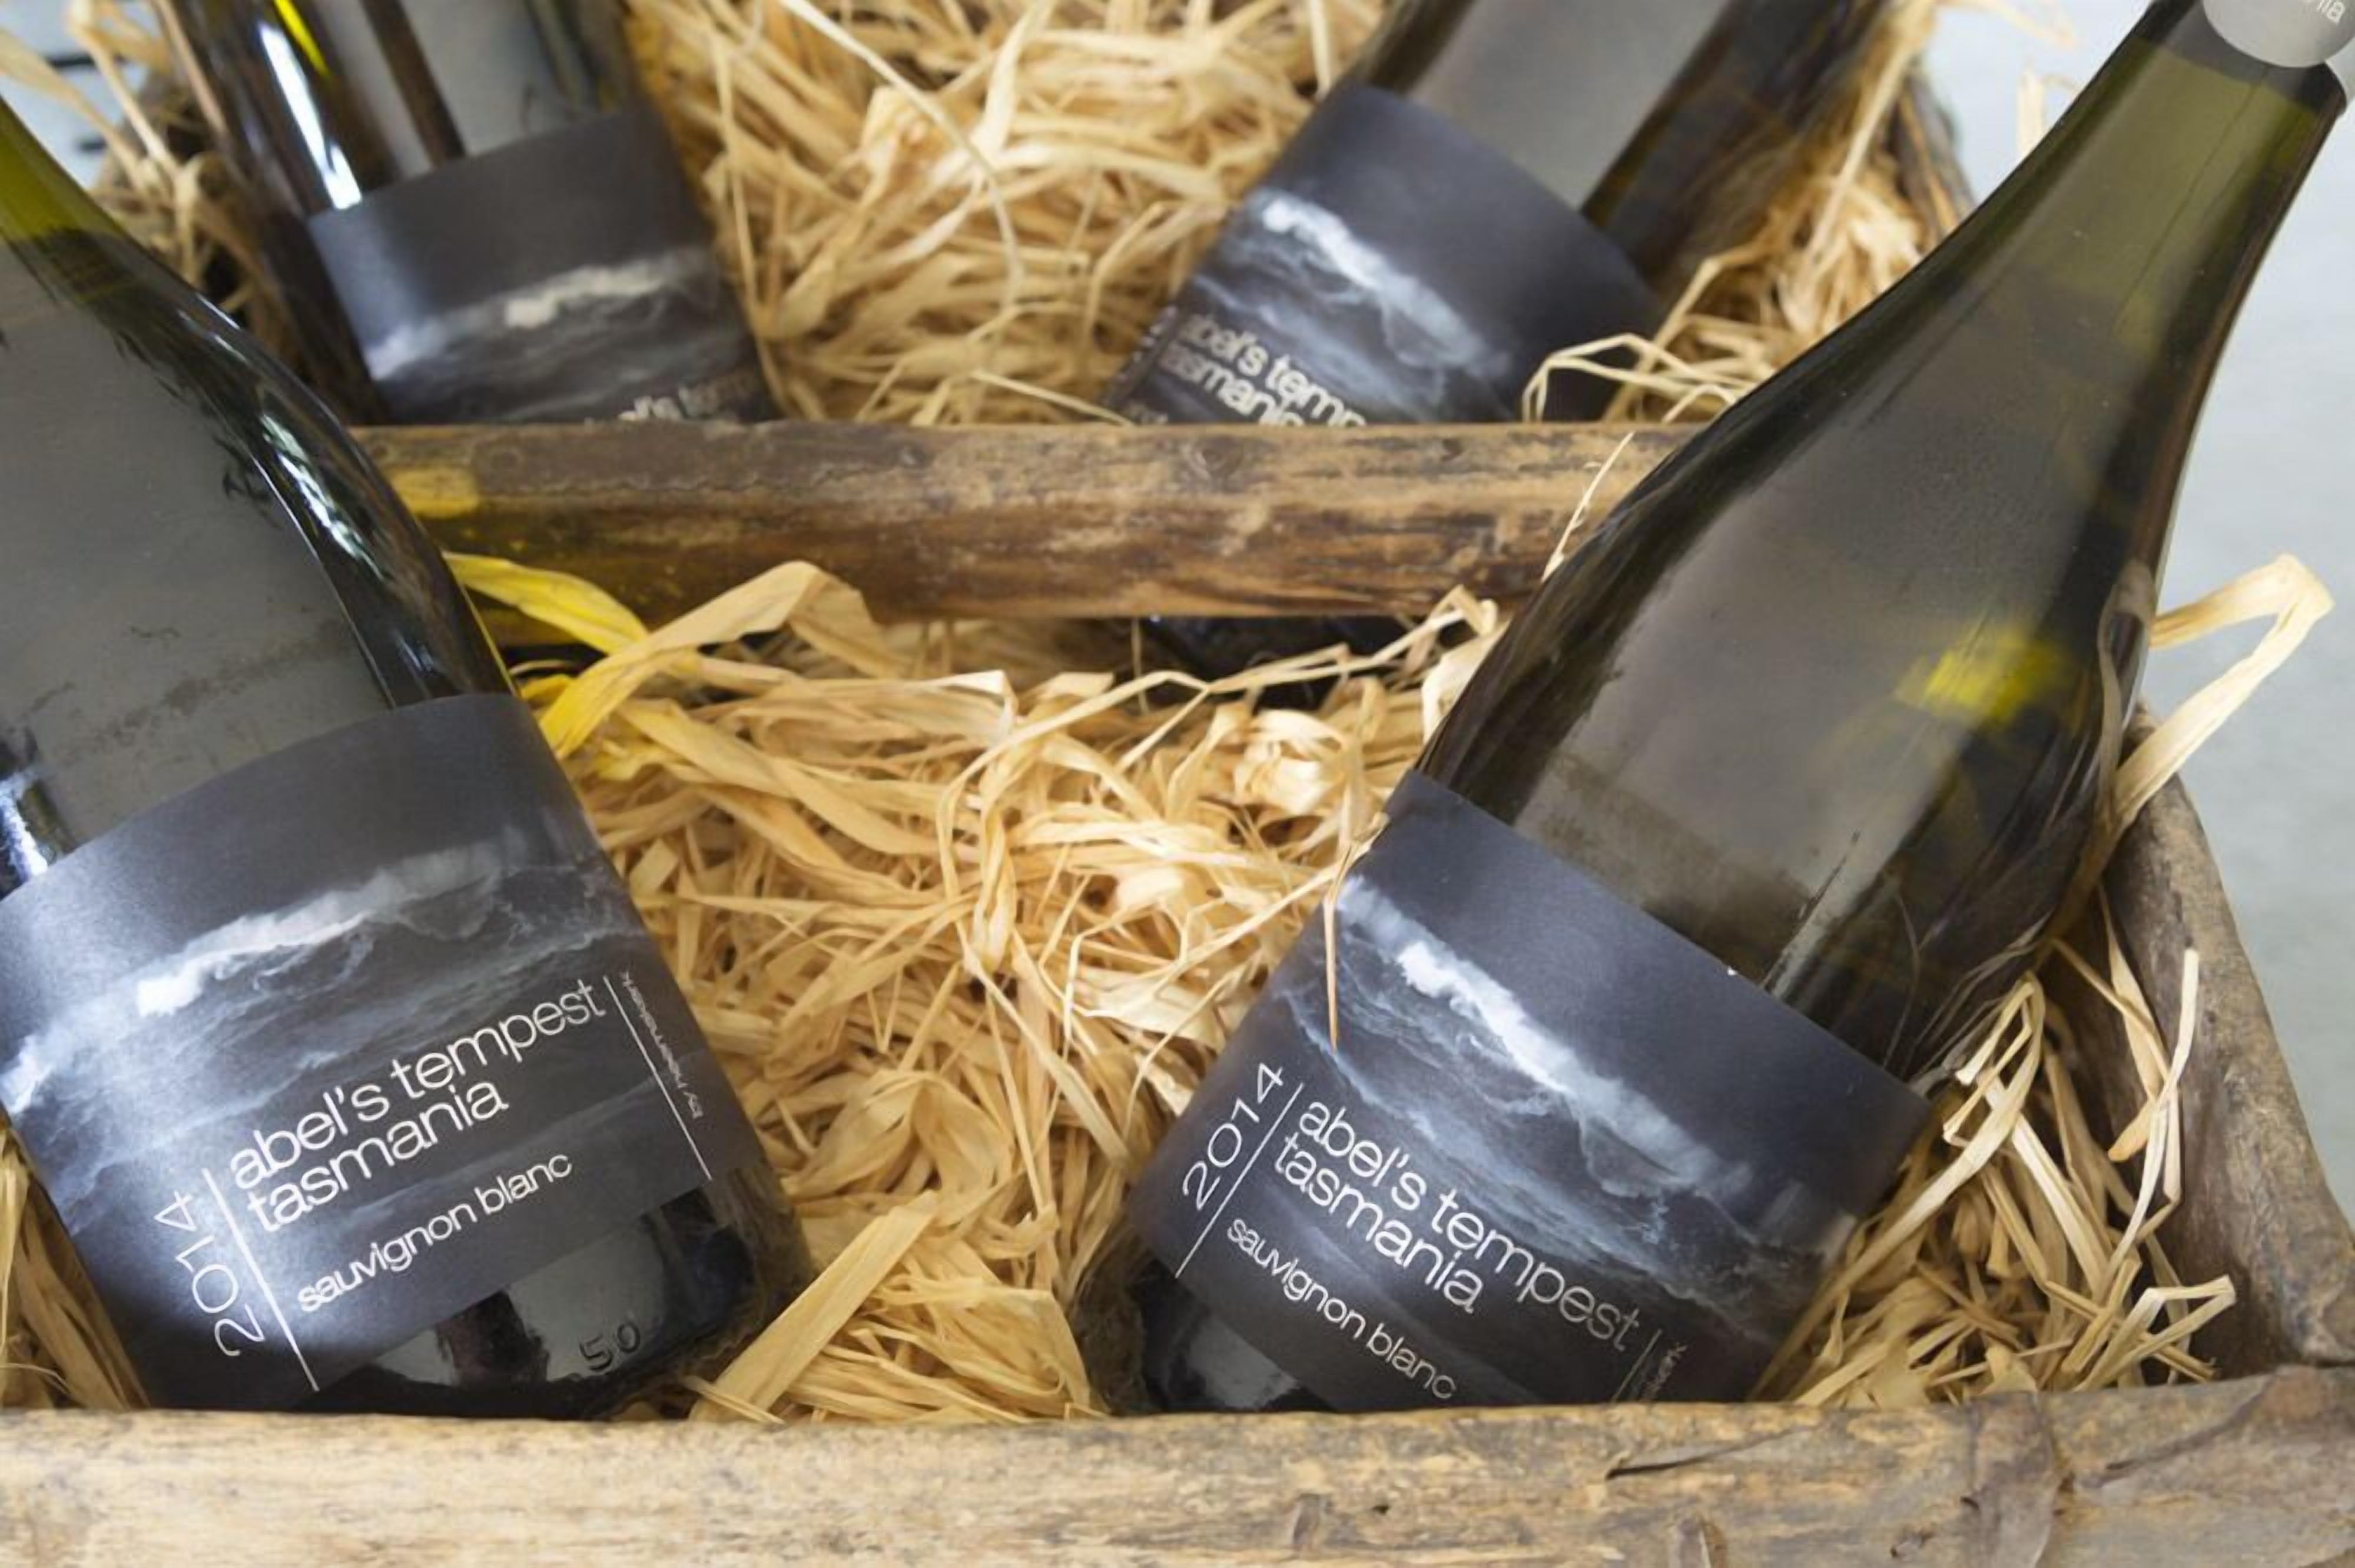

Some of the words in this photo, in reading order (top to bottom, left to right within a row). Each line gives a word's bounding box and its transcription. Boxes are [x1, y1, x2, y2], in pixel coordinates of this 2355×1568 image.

[228, 1084, 391, 1191] abel's
[390, 978, 608, 1099] tempest
[247, 1080, 510, 1232] tasmania
[1182, 1062, 1285, 1211] 2014
[154, 1189, 268, 1358] 2014
[296, 1200, 479, 1313] sauvignon
[475, 1152, 574, 1218] blanc
[1226, 1217, 1368, 1342] sauvignon
[1365, 1321, 1457, 1400] blanc
[1272, 1132, 1484, 1315] tasmania
[1298, 1100, 1427, 1211] abel's
[1431, 1188, 1640, 1353] tempest
